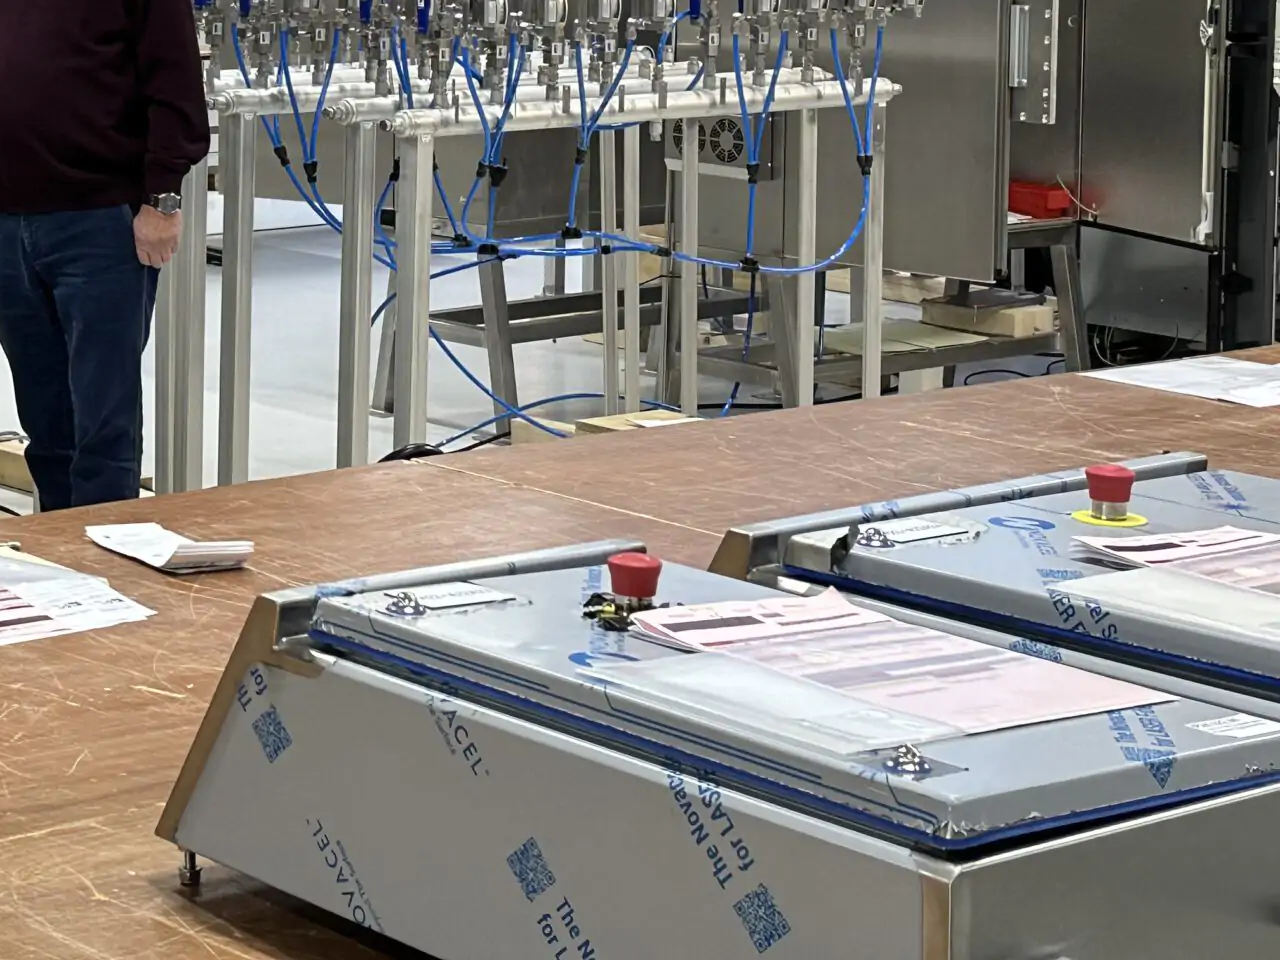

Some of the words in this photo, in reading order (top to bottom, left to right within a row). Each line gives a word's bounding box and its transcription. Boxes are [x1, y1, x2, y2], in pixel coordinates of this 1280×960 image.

[250, 667, 268, 695] for
[312, 819, 372, 930] OVACEL
[706, 844, 733, 890] The
[730, 838, 754, 872] for
[536, 913, 559, 944] for
[556, 895, 580, 940] The
[577, 939, 597, 960] N
